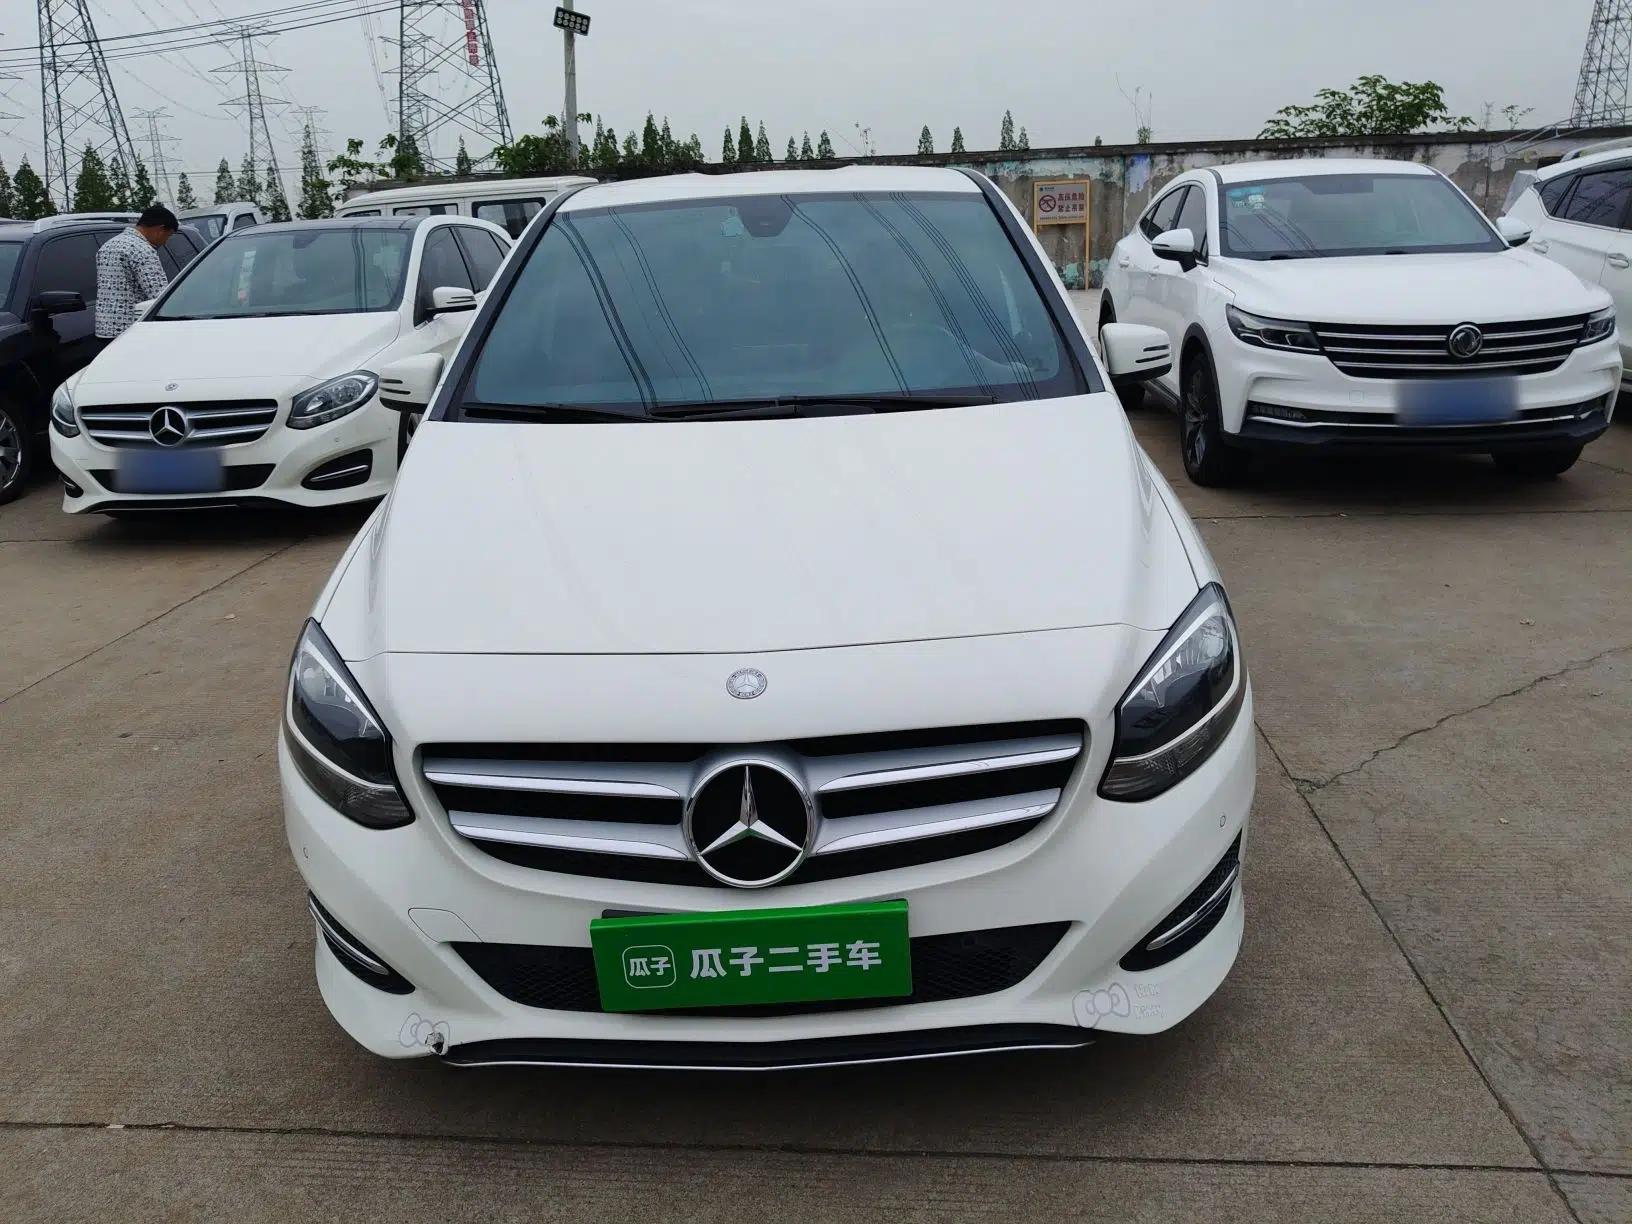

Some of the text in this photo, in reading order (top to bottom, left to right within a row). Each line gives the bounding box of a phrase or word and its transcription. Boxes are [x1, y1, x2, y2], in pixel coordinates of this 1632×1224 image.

[629, 957, 671, 977] 瓜子
[690, 940, 882, 979] 瓜子二手车
